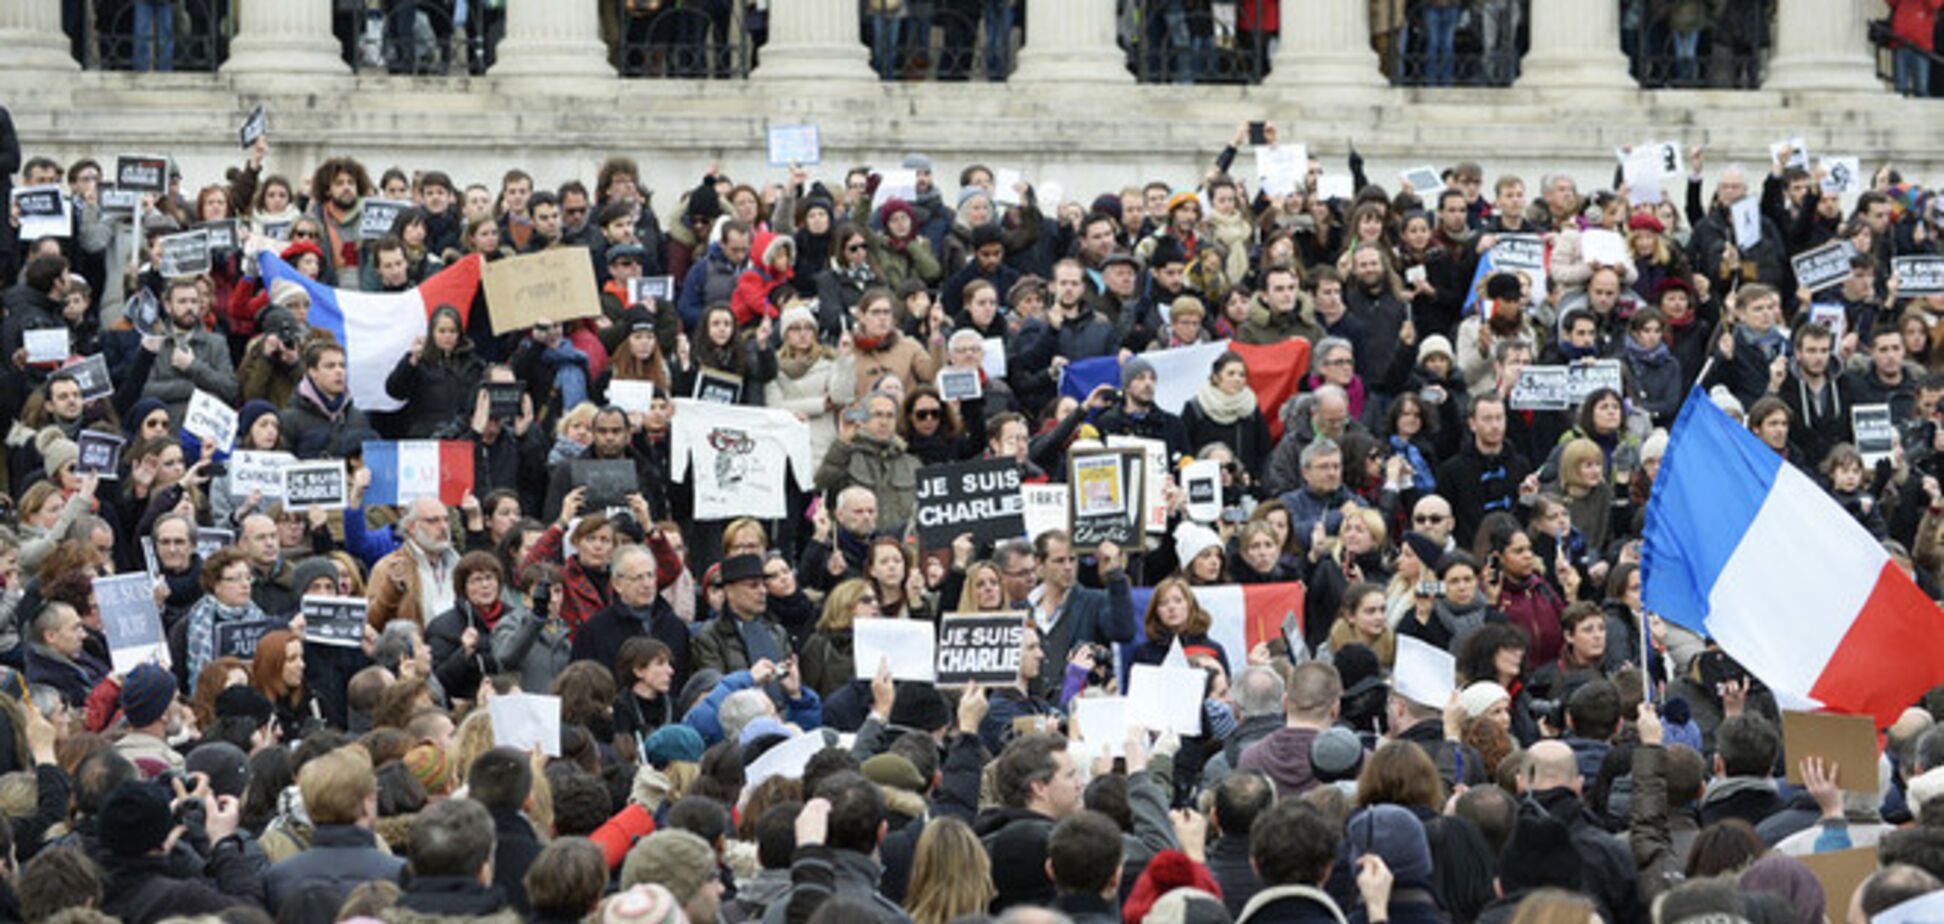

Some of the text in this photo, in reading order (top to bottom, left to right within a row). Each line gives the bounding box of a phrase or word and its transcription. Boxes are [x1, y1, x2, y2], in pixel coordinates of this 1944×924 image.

[918, 468, 1020, 499] JE SUIS
[919, 494, 1023, 525] CHARLIE
[940, 626, 1024, 647] JE SUIS
[939, 648, 1021, 672] CHARLIE
